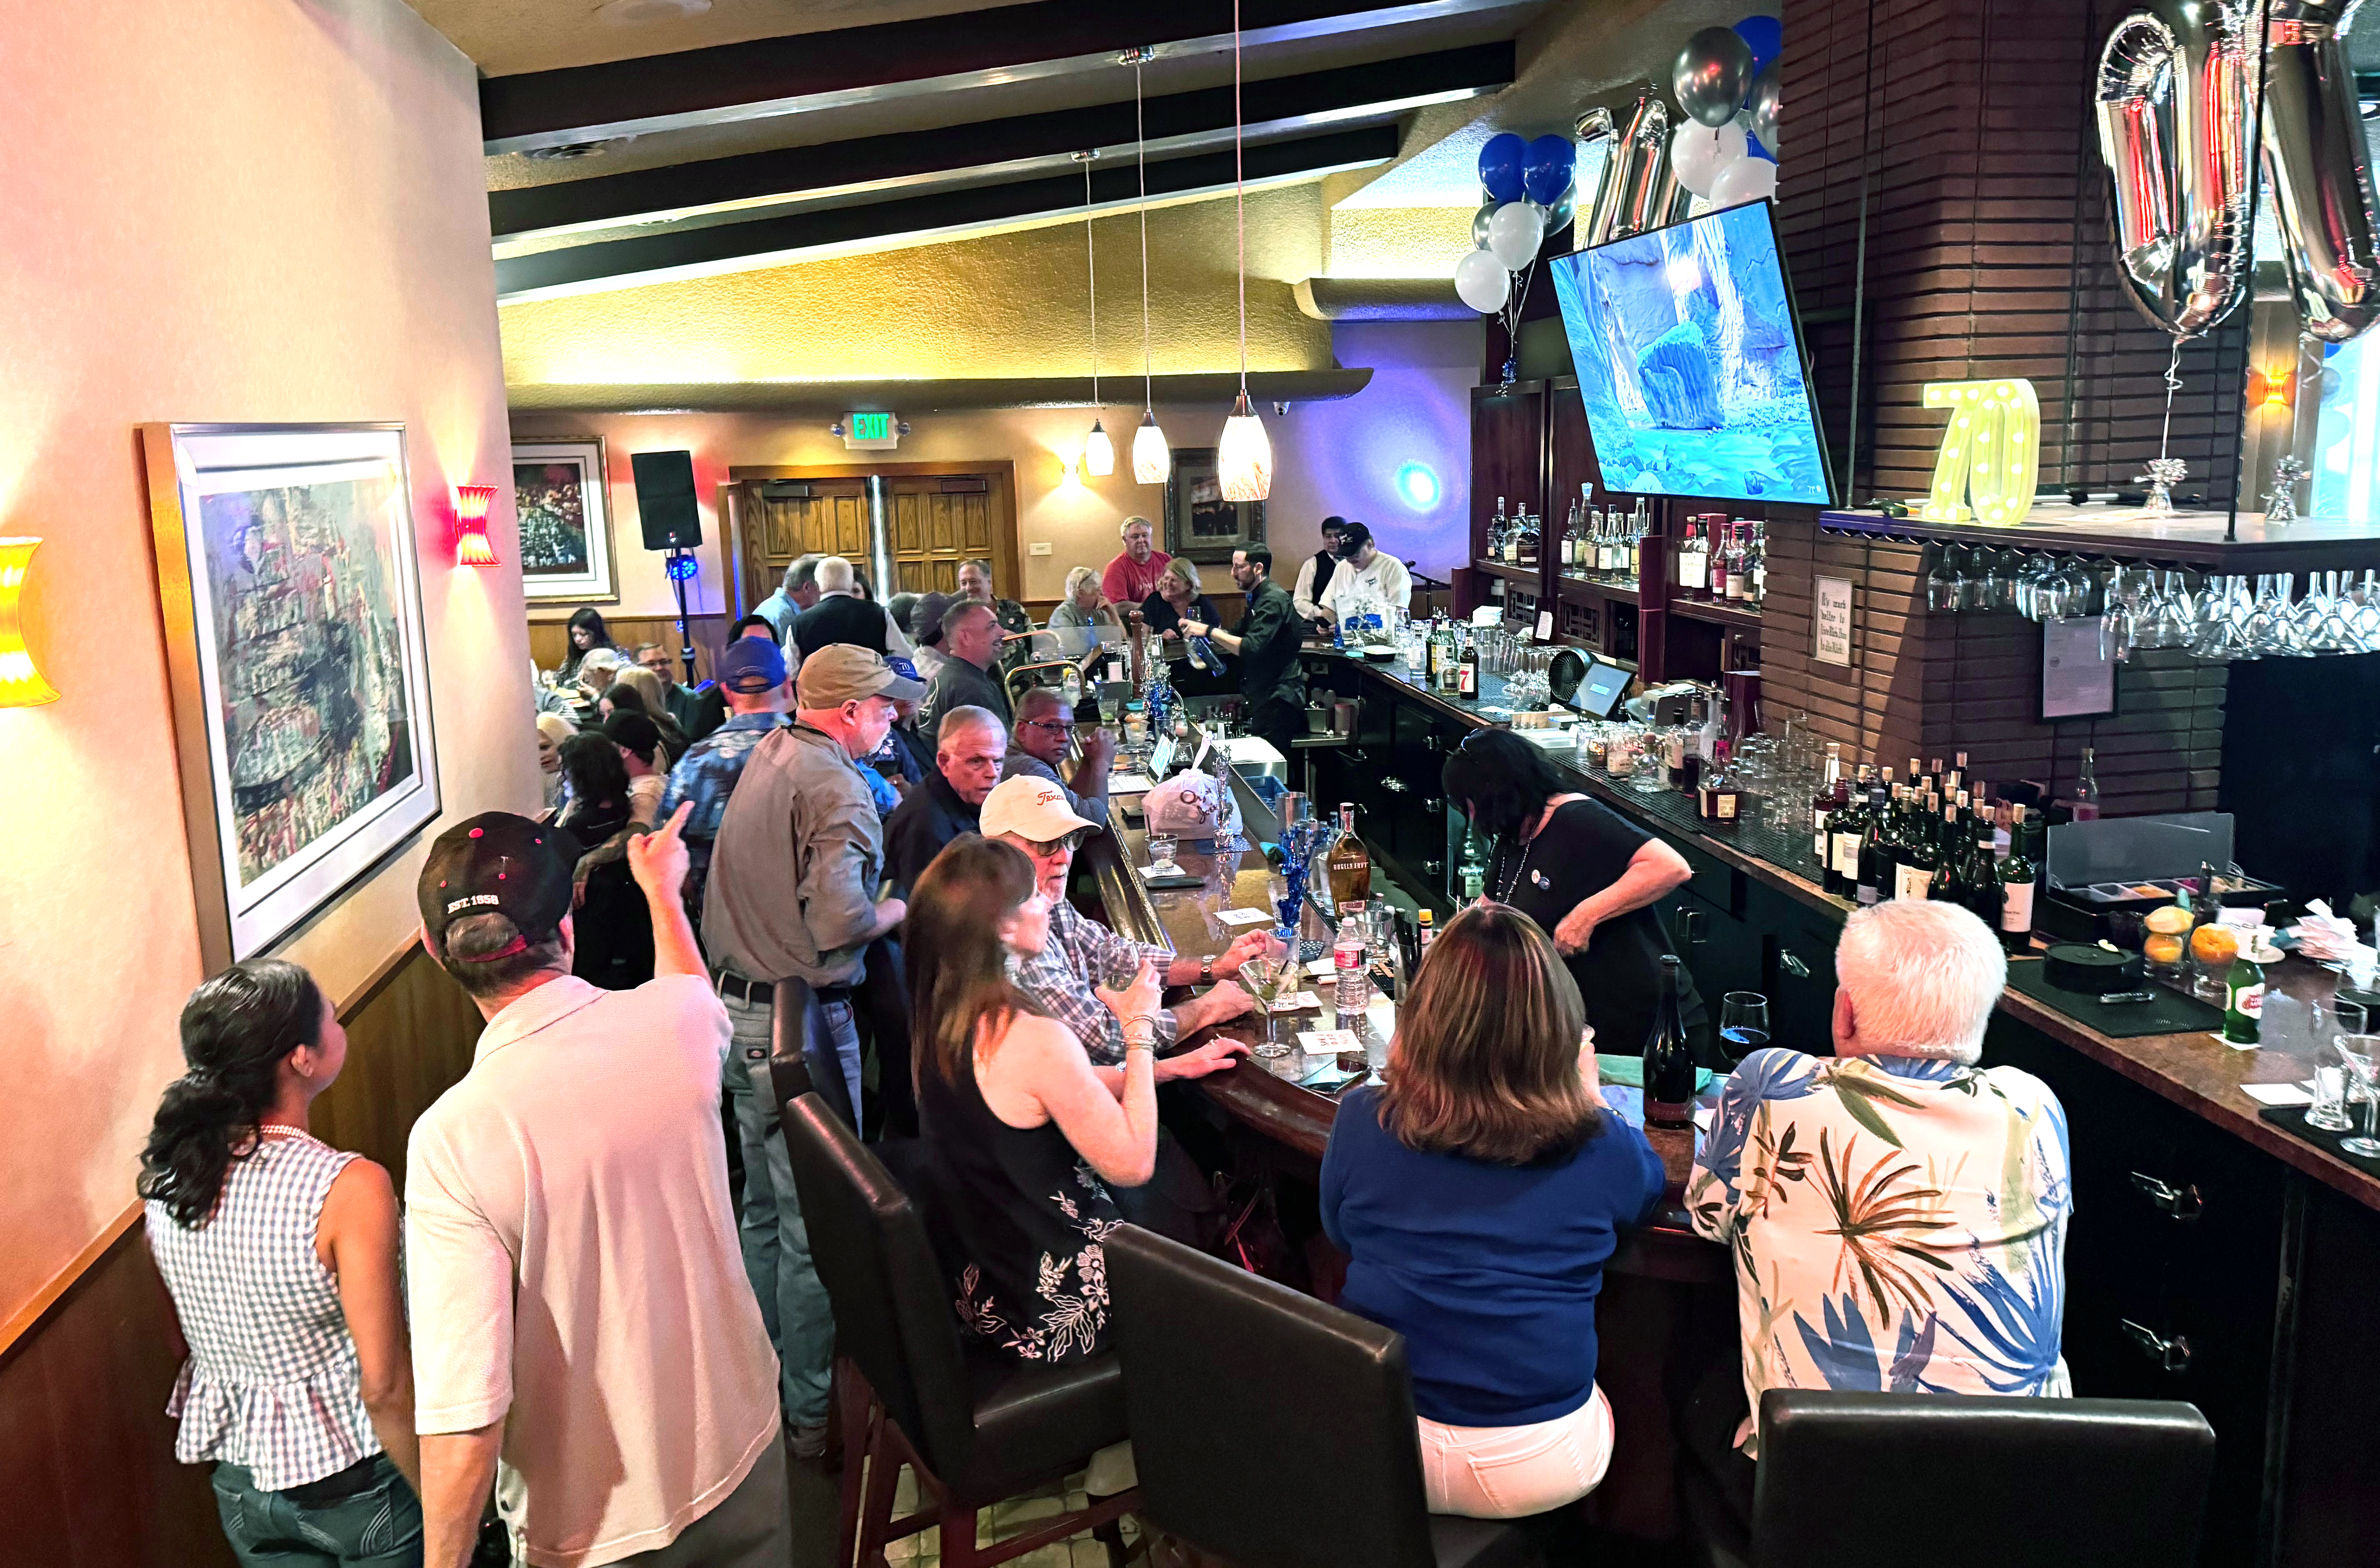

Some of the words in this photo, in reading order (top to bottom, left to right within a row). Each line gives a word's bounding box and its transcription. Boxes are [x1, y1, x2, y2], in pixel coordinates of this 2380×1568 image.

[853, 414, 889, 439] EXIT
[1922, 379, 2040, 526] 70
[1460, 671, 1470, 690] 7
